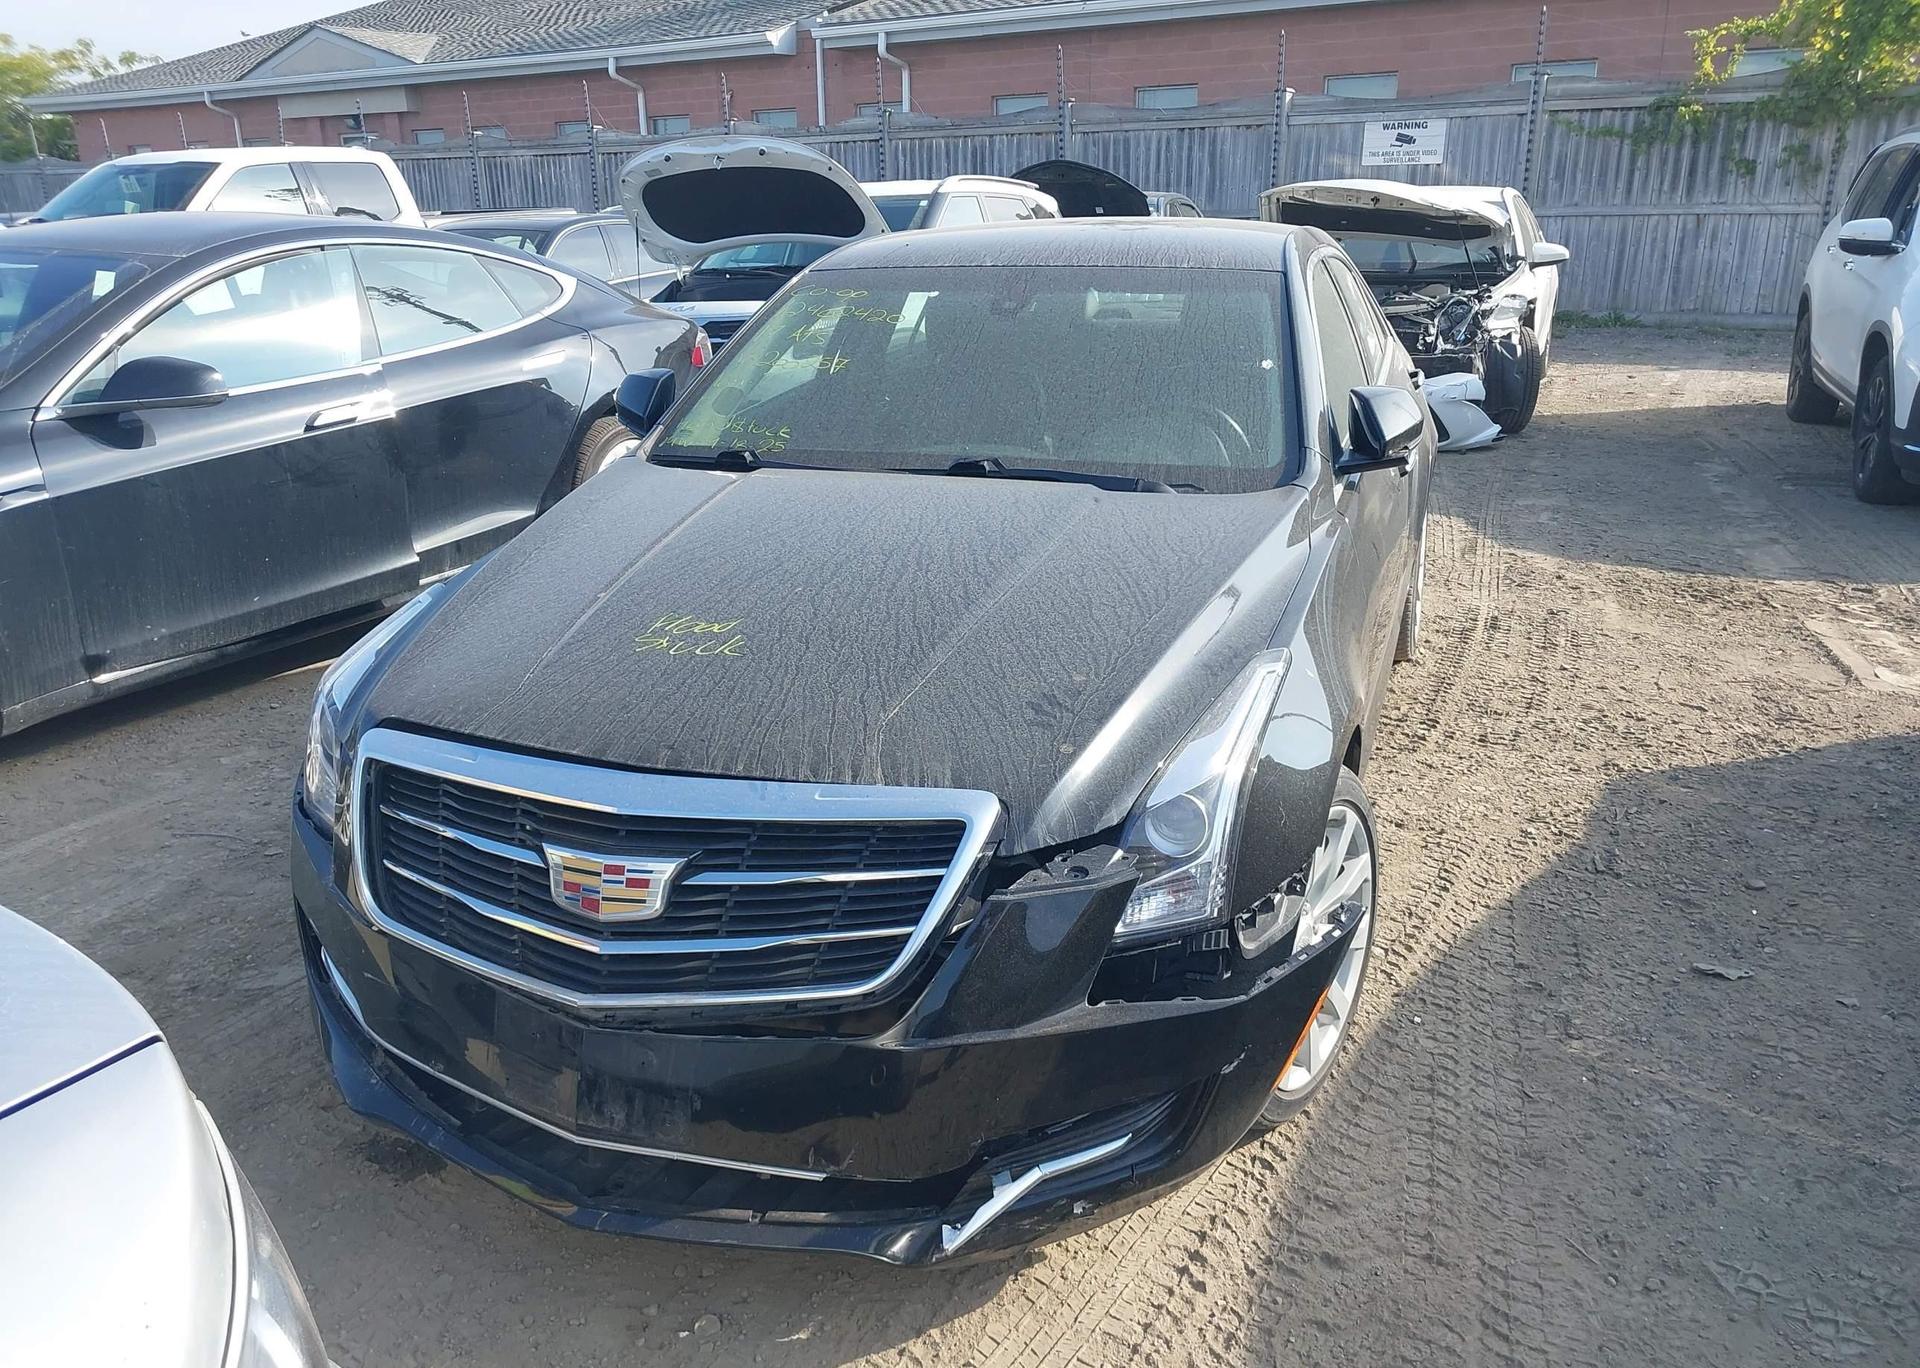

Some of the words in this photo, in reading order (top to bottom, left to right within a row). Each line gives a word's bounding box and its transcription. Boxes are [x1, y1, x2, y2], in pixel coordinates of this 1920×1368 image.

[1382, 121, 1429, 131] WARNING
[1402, 149, 1420, 157] UNDER
[1421, 148, 1438, 156] VIDEO
[1383, 156, 1421, 164] SURVEILLANCE
